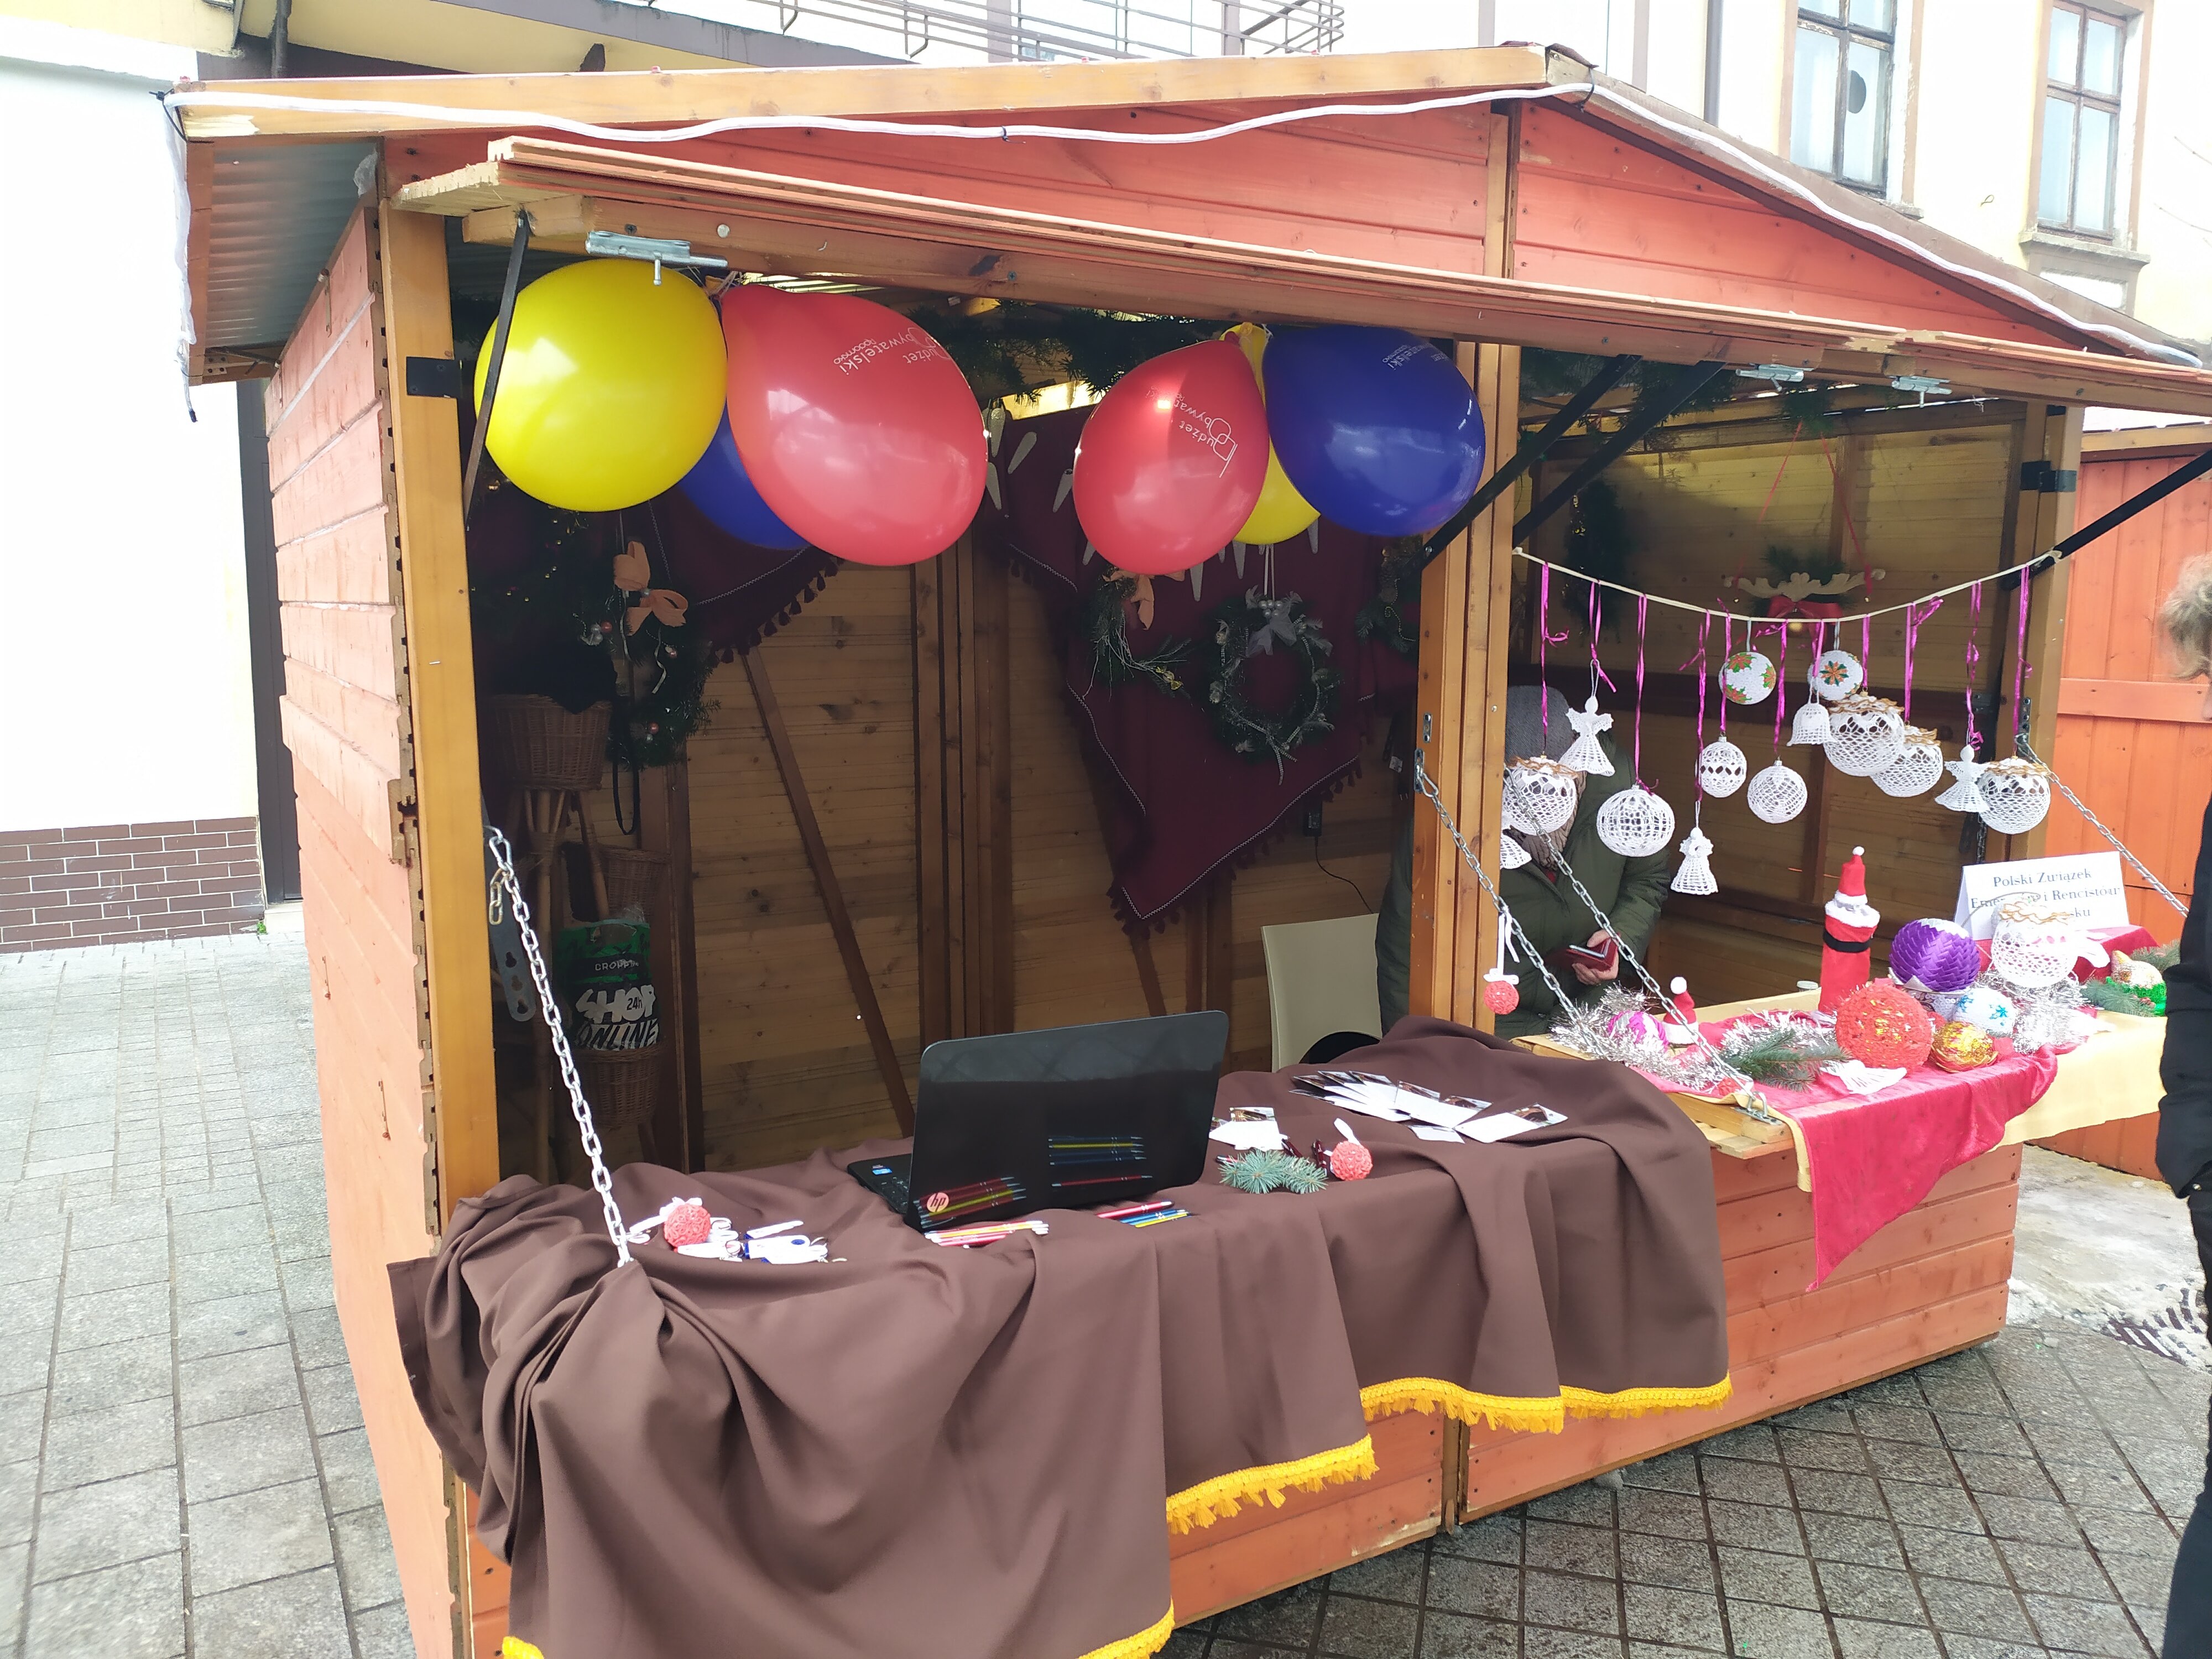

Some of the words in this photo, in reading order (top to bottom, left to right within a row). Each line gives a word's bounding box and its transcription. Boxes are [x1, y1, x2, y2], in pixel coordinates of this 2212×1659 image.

[1993, 873, 2033, 887] Polski
[2037, 868, 2093, 883] Związek
[2043, 891, 2048, 901] i
[2052, 885, 2121, 900] Rencistów
[575, 984, 656, 1024] SHOP
[626, 997, 643, 1011] 24h
[575, 1018, 659, 1051] ONLINE
[929, 1192, 947, 1212] hp
